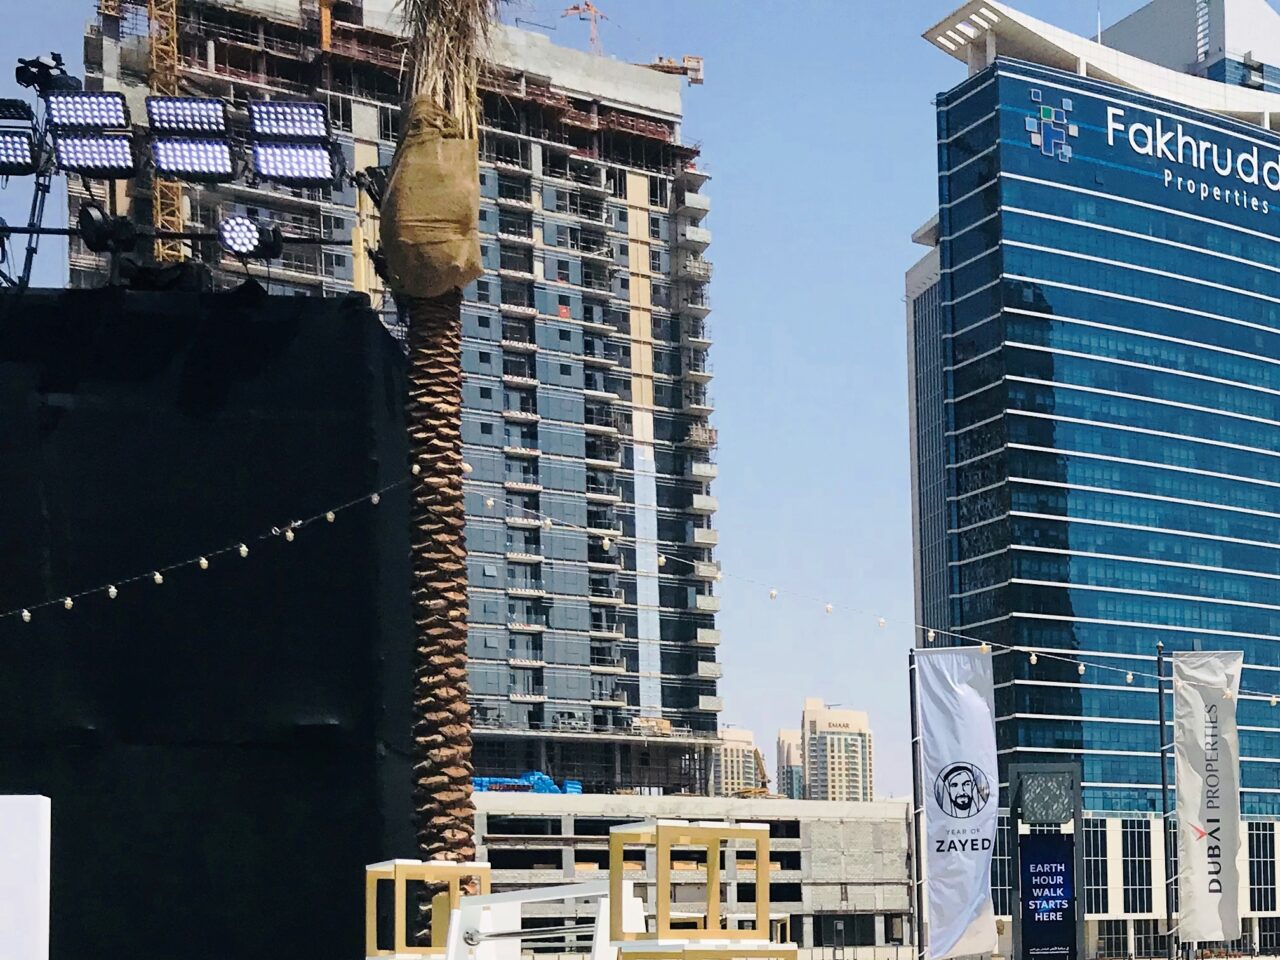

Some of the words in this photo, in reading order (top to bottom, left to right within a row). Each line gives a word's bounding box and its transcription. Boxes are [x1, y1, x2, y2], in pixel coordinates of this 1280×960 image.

[1164, 169, 1270, 214] Properties
[1205, 703, 1220, 810] PROPERTIES
[936, 838, 992, 853] ZAYED
[1207, 818, 1223, 894] DUBAI
[1030, 863, 1065, 873] EARTH
[1032, 875, 1064, 885] HOUR
[1032, 887, 1064, 897] WALK
[1028, 899, 1069, 910] STARTS
[1035, 911, 1063, 921] HERE
